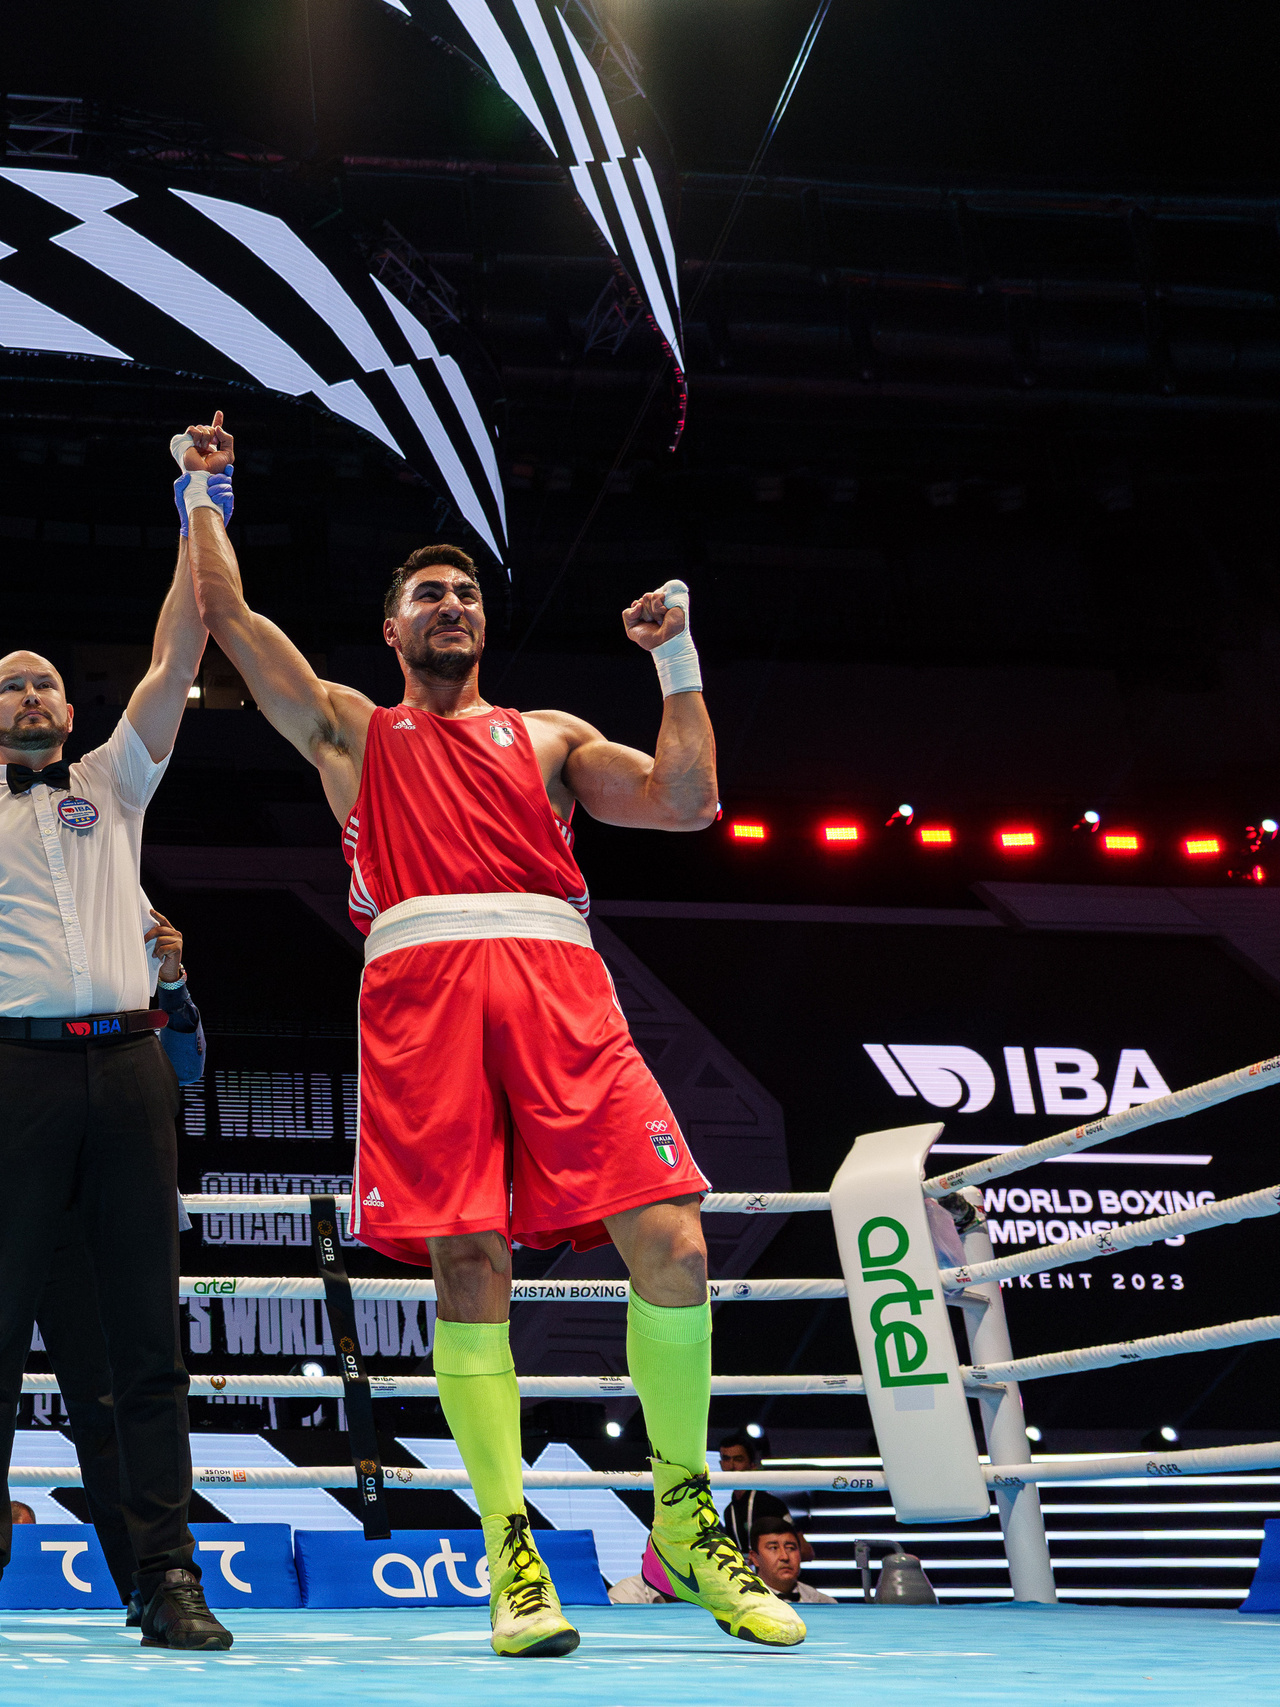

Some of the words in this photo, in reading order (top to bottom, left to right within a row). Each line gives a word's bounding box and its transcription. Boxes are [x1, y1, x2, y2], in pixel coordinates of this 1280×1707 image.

[93, 1018, 121, 1035] IBA
[1003, 1046, 1173, 1115] IBA
[984, 1188, 1094, 1214] WORLD
[323, 1237, 335, 1262] OFB
[194, 1278, 237, 1294] artel
[511, 1286, 566, 1298] KISTAN
[569, 1286, 626, 1298] BOXING
[1111, 1273, 1185, 1290] 2023
[857, 1216, 949, 1388] artel
[346, 1355, 360, 1379] OFB
[365, 1477, 378, 1502] OFB
[850, 1478, 874, 1490] OFB
